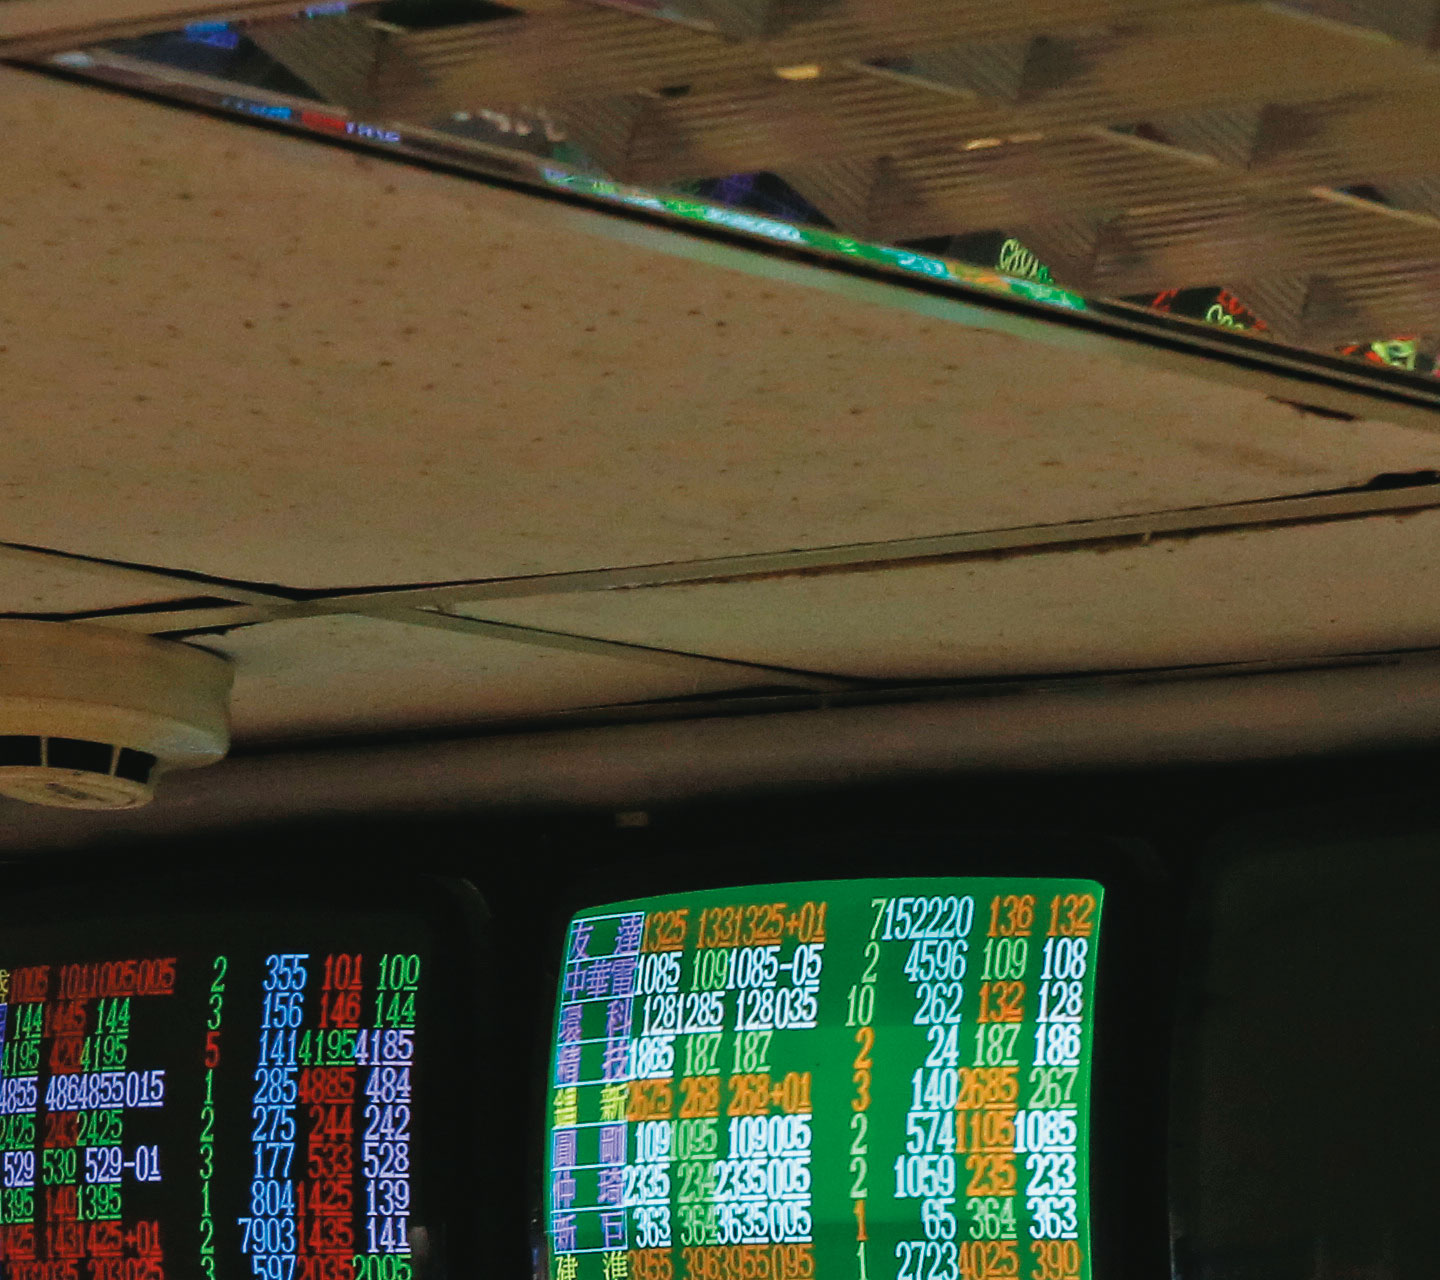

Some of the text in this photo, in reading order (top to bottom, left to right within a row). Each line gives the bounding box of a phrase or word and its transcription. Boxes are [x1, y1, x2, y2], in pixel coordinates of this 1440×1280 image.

[988, 895, 1093, 936] 136 132
[263, 955, 419, 990] 355 100
[905, 941, 967, 982] 4596
[981, 940, 1027, 979] 109
[1042, 939, 1086, 979] 108
[96, 994, 415, 1035] 144 156 144
[845, 982, 1082, 1026] 10 262 132 128
[258, 1029, 413, 1065] 141 4185
[927, 1025, 1080, 1067] 24 187 186
[255, 1068, 410, 1103] 285 484
[252, 1105, 410, 1141] 275 242
[907, 1112, 956, 1153] 574
[253, 1142, 409, 1178] 177 528
[894, 1155, 1076, 1197] 1059 233
[251, 1179, 410, 1216] 804 139
[238, 1217, 410, 1253] 7903 141
[921, 1199, 1077, 1240] 65 363
